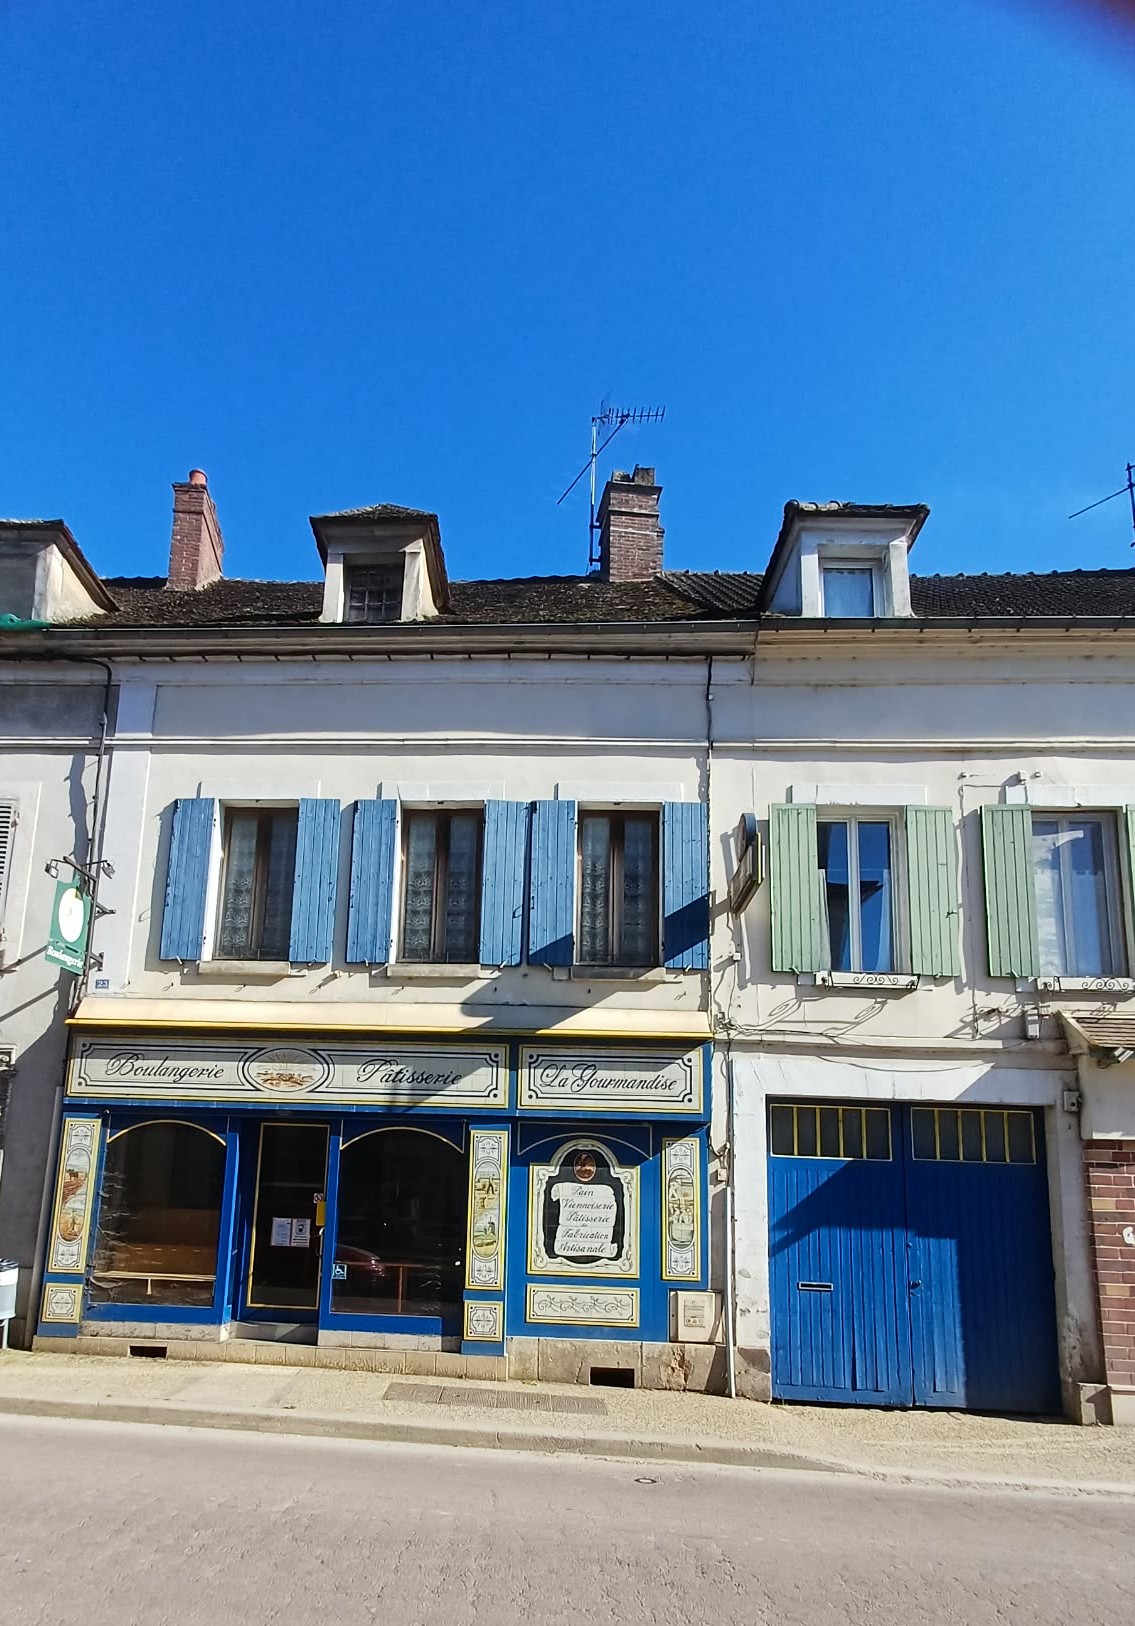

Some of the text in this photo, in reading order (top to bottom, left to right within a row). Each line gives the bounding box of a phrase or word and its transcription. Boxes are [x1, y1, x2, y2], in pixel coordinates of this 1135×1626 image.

[105, 1052, 225, 1082] Boulangerie
[356, 1058, 463, 1086] Pâtisserie
[539, 1063, 678, 1093] La Gourmandise
[571, 1185, 595, 1197] Pain
[562, 1198, 615, 1210] Viennoiserie
[565, 1211, 610, 1223] Pâtisserie
[562, 1228, 609, 1240] Fabrication
[560, 1242, 607, 1254] Artisanale
